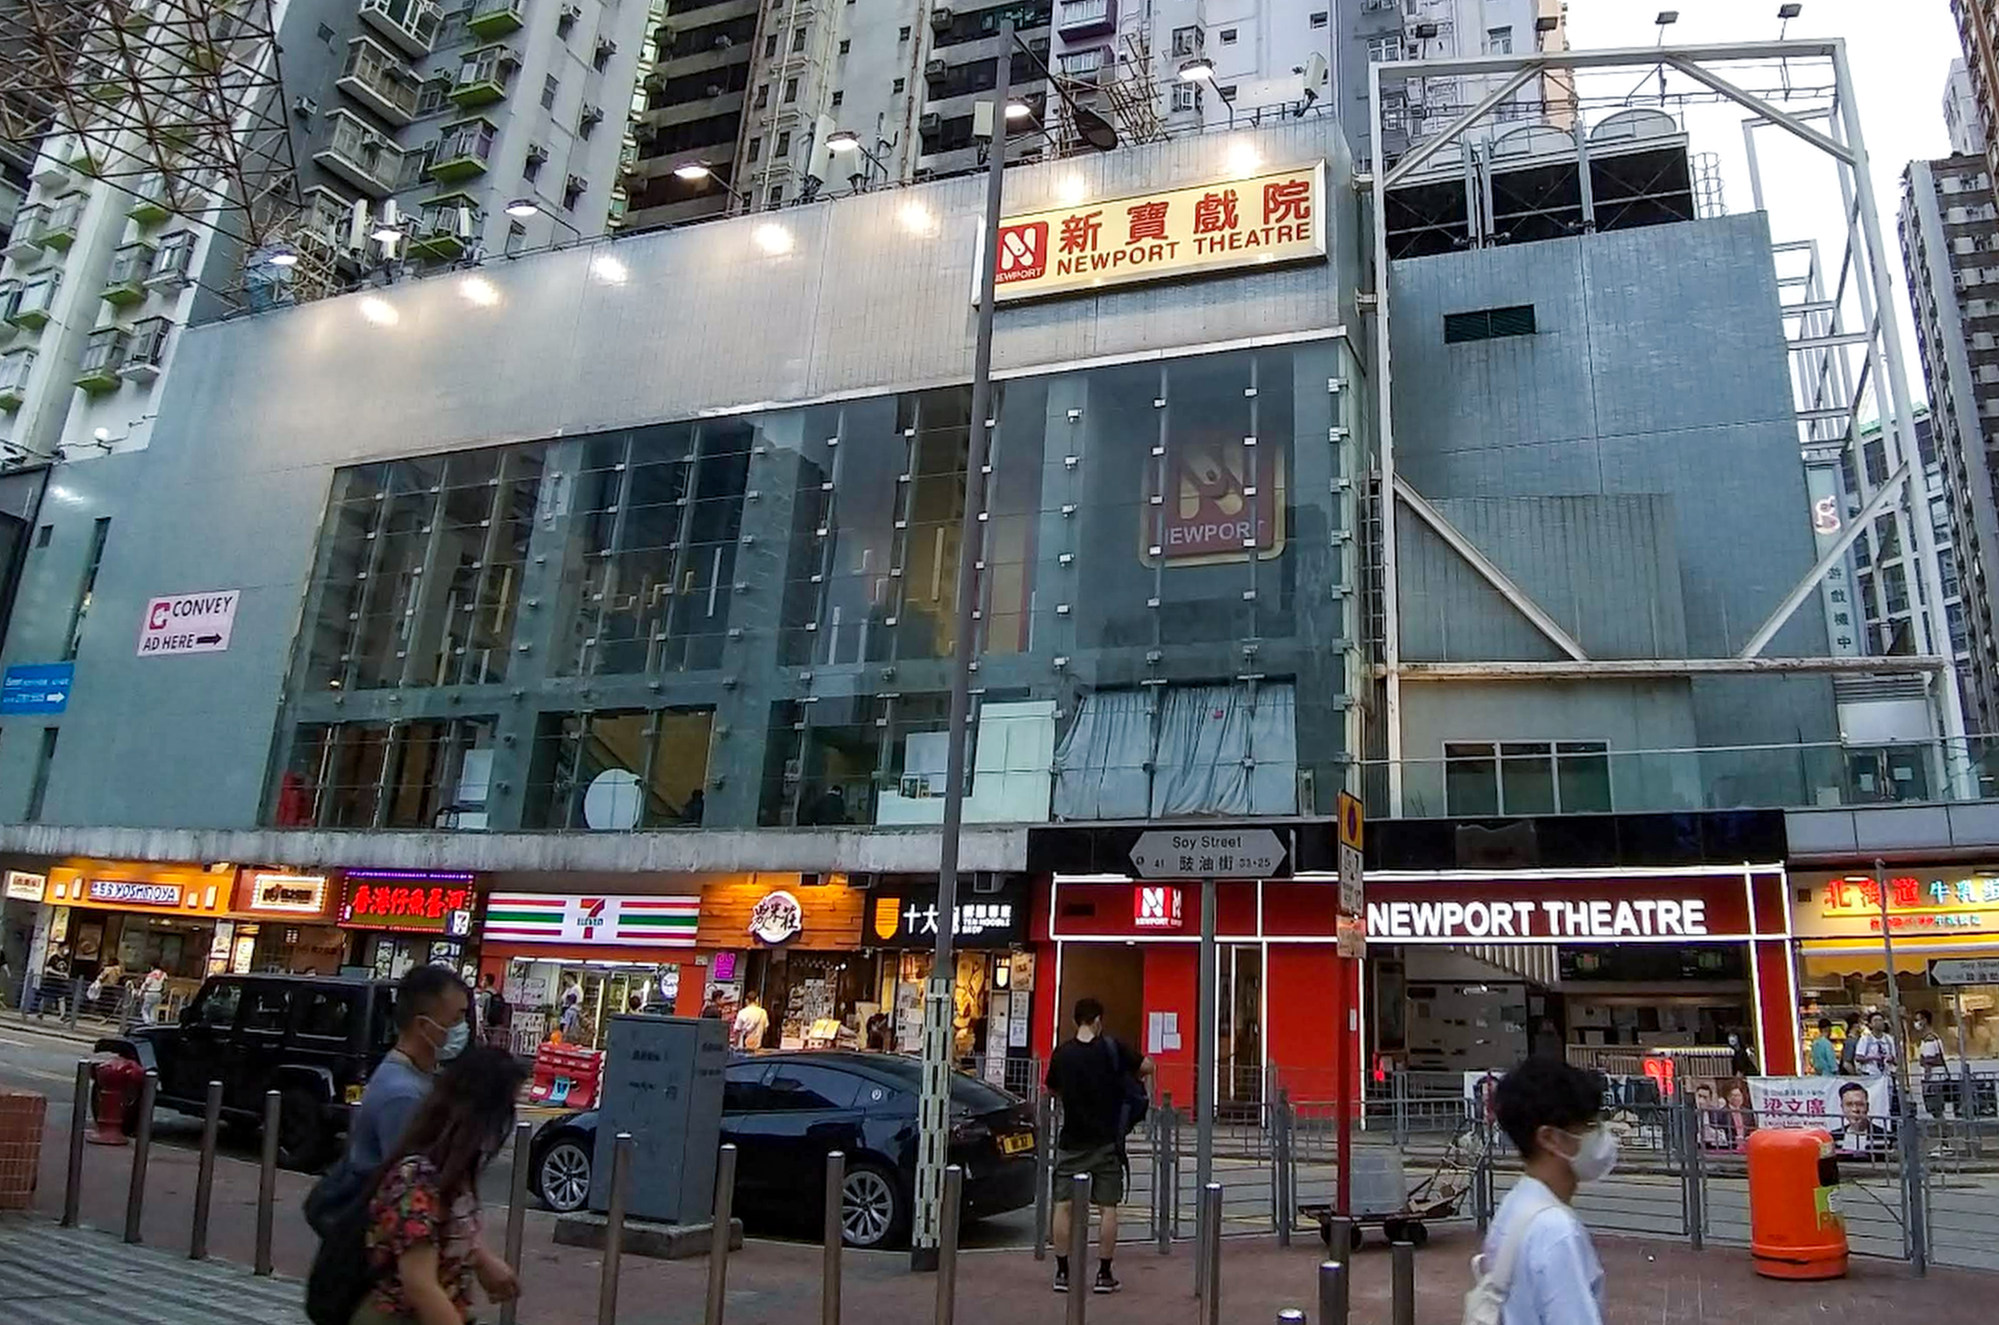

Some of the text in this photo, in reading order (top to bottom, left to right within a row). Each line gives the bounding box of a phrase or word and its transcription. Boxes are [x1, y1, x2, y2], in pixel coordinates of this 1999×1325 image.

[1060, 180, 1310, 255] 新寶戲院
[1057, 223, 1311, 276] NEWPORT THEATRE
[995, 267, 1043, 282] EWPORT
[1164, 519, 1265, 546] EWPOR
[172, 596, 233, 617] CONVEY
[143, 634, 195, 651] AD HERE
[1173, 836, 1242, 850] Soy Street
[1179, 855, 1234, 872] 豉油街
[1366, 901, 1535, 937] NEWPORT
[1541, 900, 1708, 936] THEATRE
